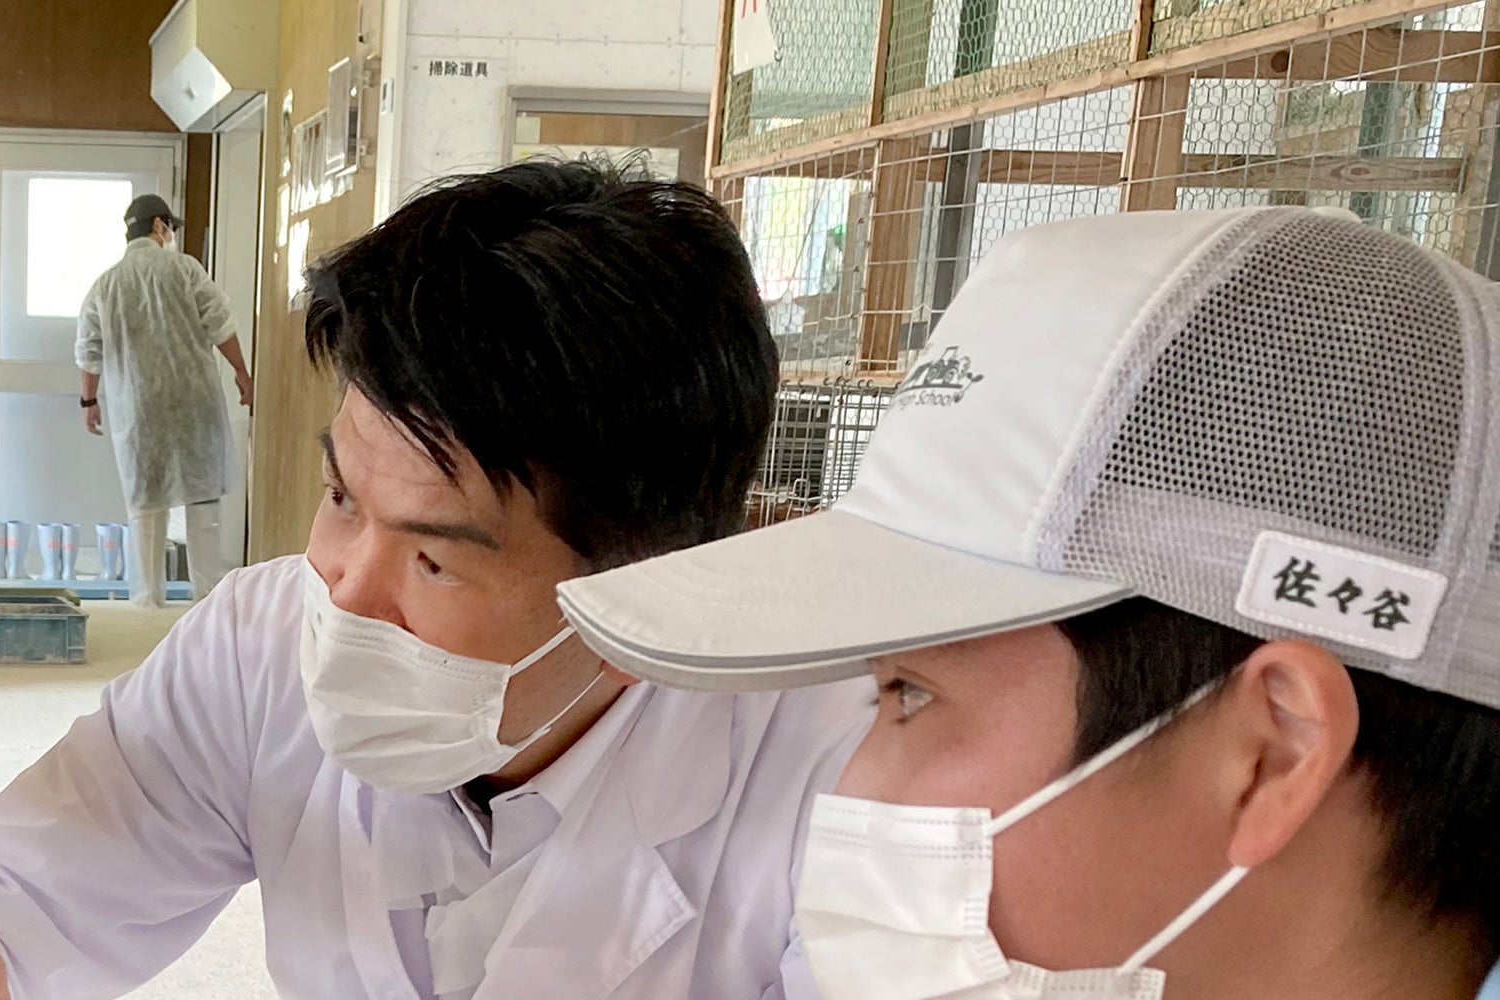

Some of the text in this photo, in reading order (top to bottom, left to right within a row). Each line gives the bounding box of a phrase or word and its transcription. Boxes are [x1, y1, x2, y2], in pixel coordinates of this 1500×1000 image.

[429, 60, 488, 77] 掃除道具
[914, 389, 955, 407] School
[1273, 556, 1411, 631] 佐々谷
